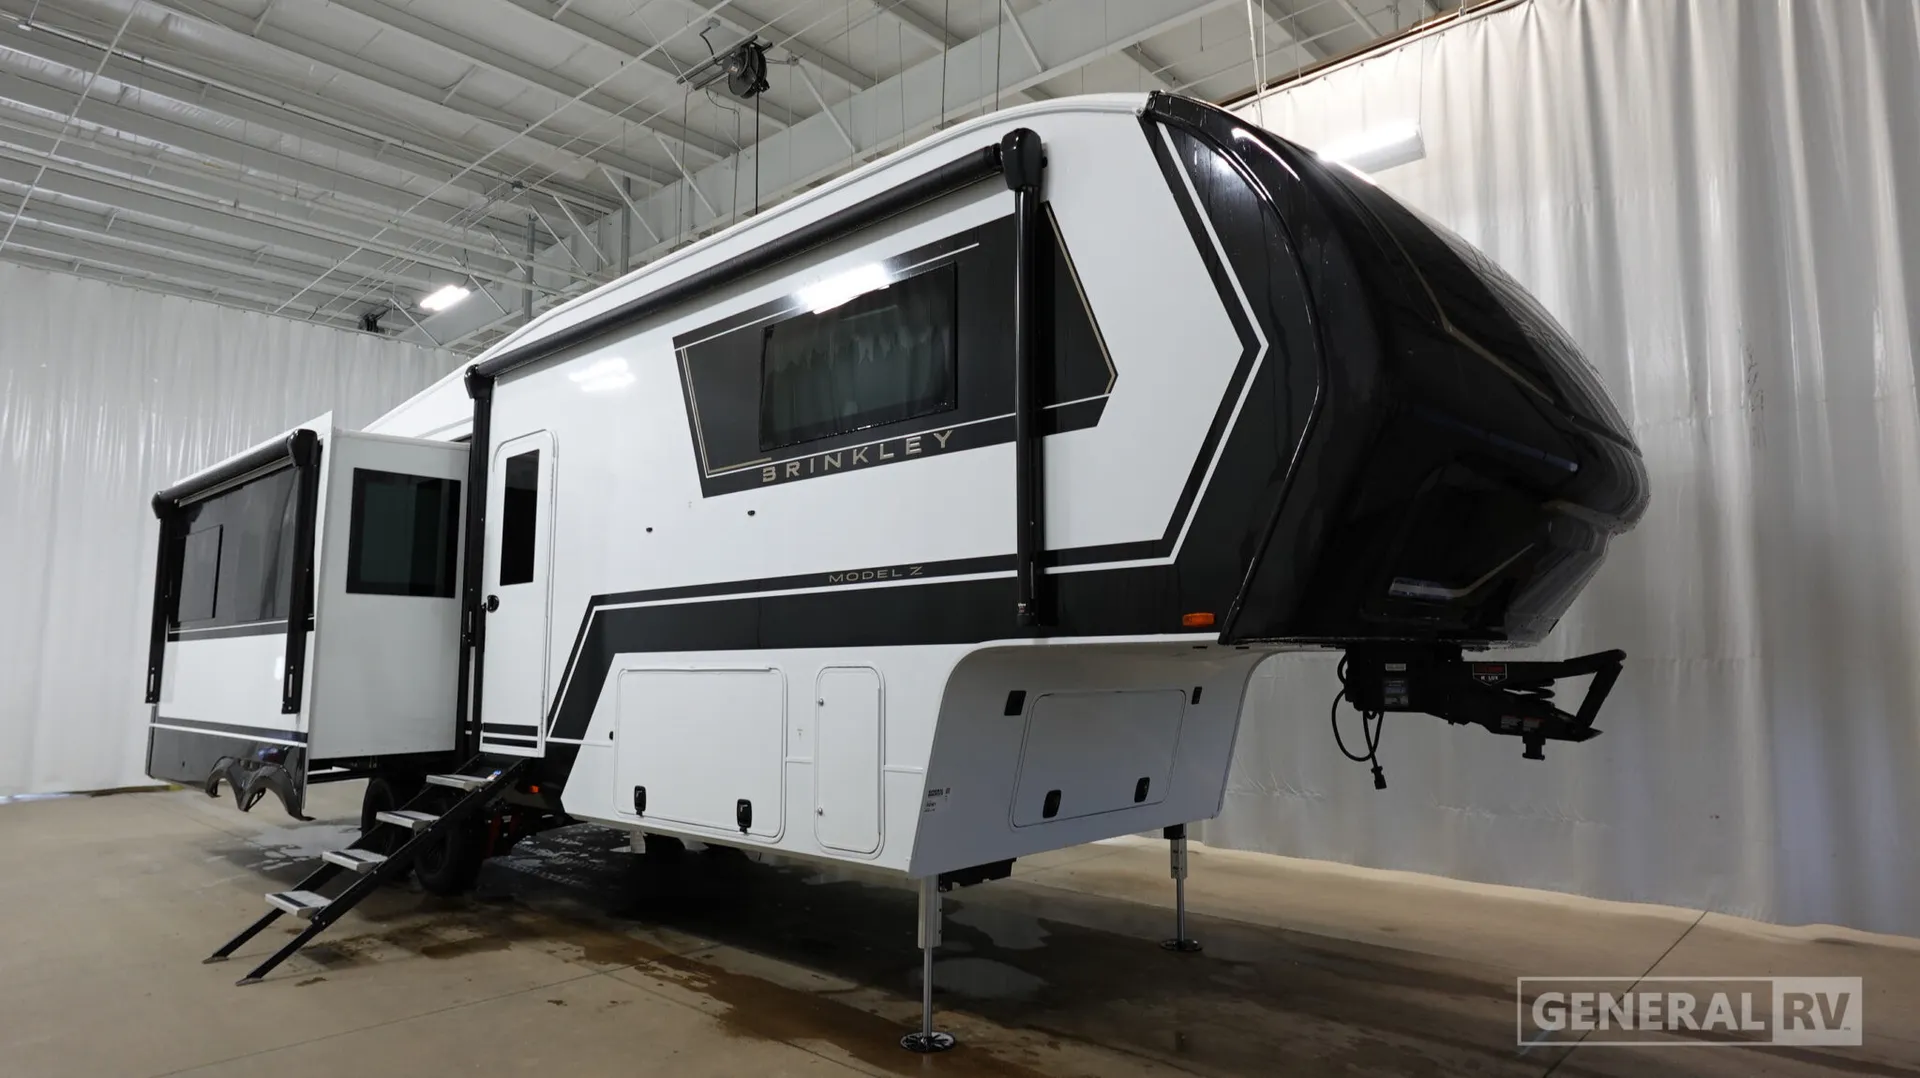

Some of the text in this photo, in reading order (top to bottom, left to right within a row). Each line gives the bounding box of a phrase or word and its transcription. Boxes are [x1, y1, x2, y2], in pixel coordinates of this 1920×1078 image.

[763, 431, 953, 482] BRINKLEY
[829, 566, 923, 583] MODEL Z
